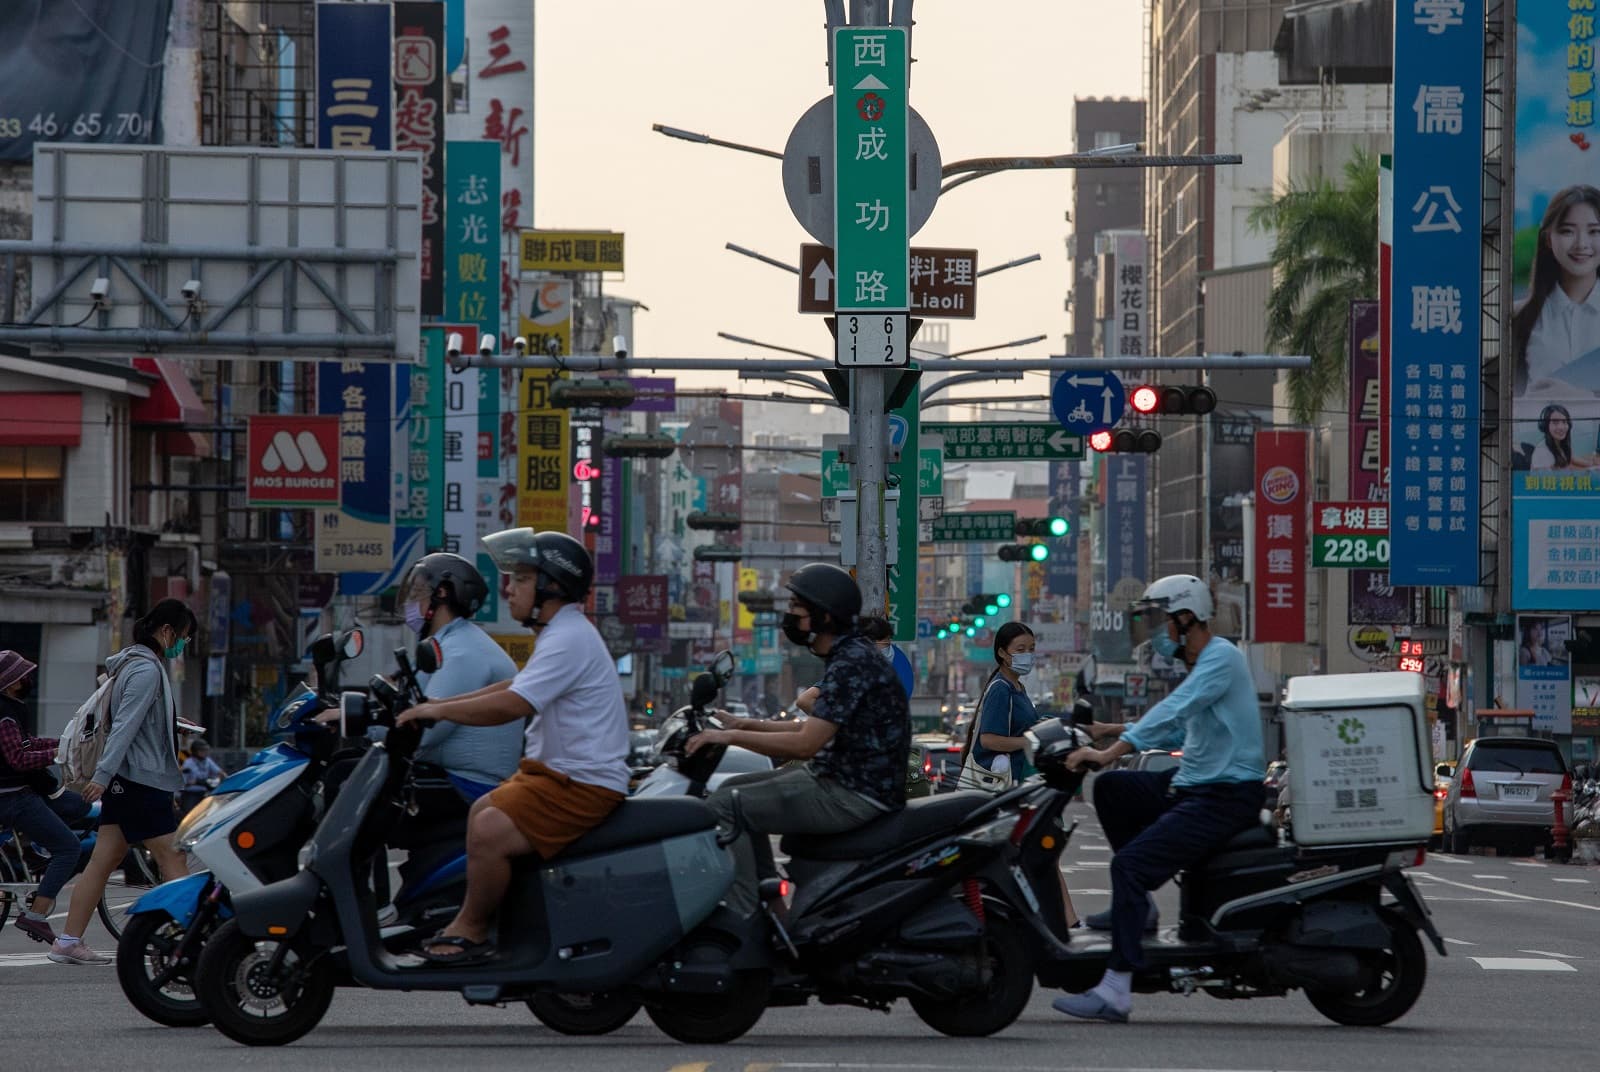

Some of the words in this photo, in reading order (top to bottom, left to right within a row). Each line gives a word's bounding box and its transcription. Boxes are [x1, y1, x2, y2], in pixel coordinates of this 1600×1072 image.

[852, 34, 888, 67] 西
[116, 113, 152, 137] 70
[1411, 0, 1464, 334] 學儒公職
[855, 126, 890, 303] 成功路
[524, 239, 623, 263] 聯成電腦
[910, 255, 974, 287] 料理
[909, 293, 965, 310] Liaoli
[253, 478, 281, 488] MOS
[285, 477, 334, 488] BURGER
[1268, 481, 1295, 496] KING
[1321, 508, 1388, 530] 拿坡里
[1266, 514, 1293, 608] 漢堡王
[1324, 539, 1389, 562] 228-0
